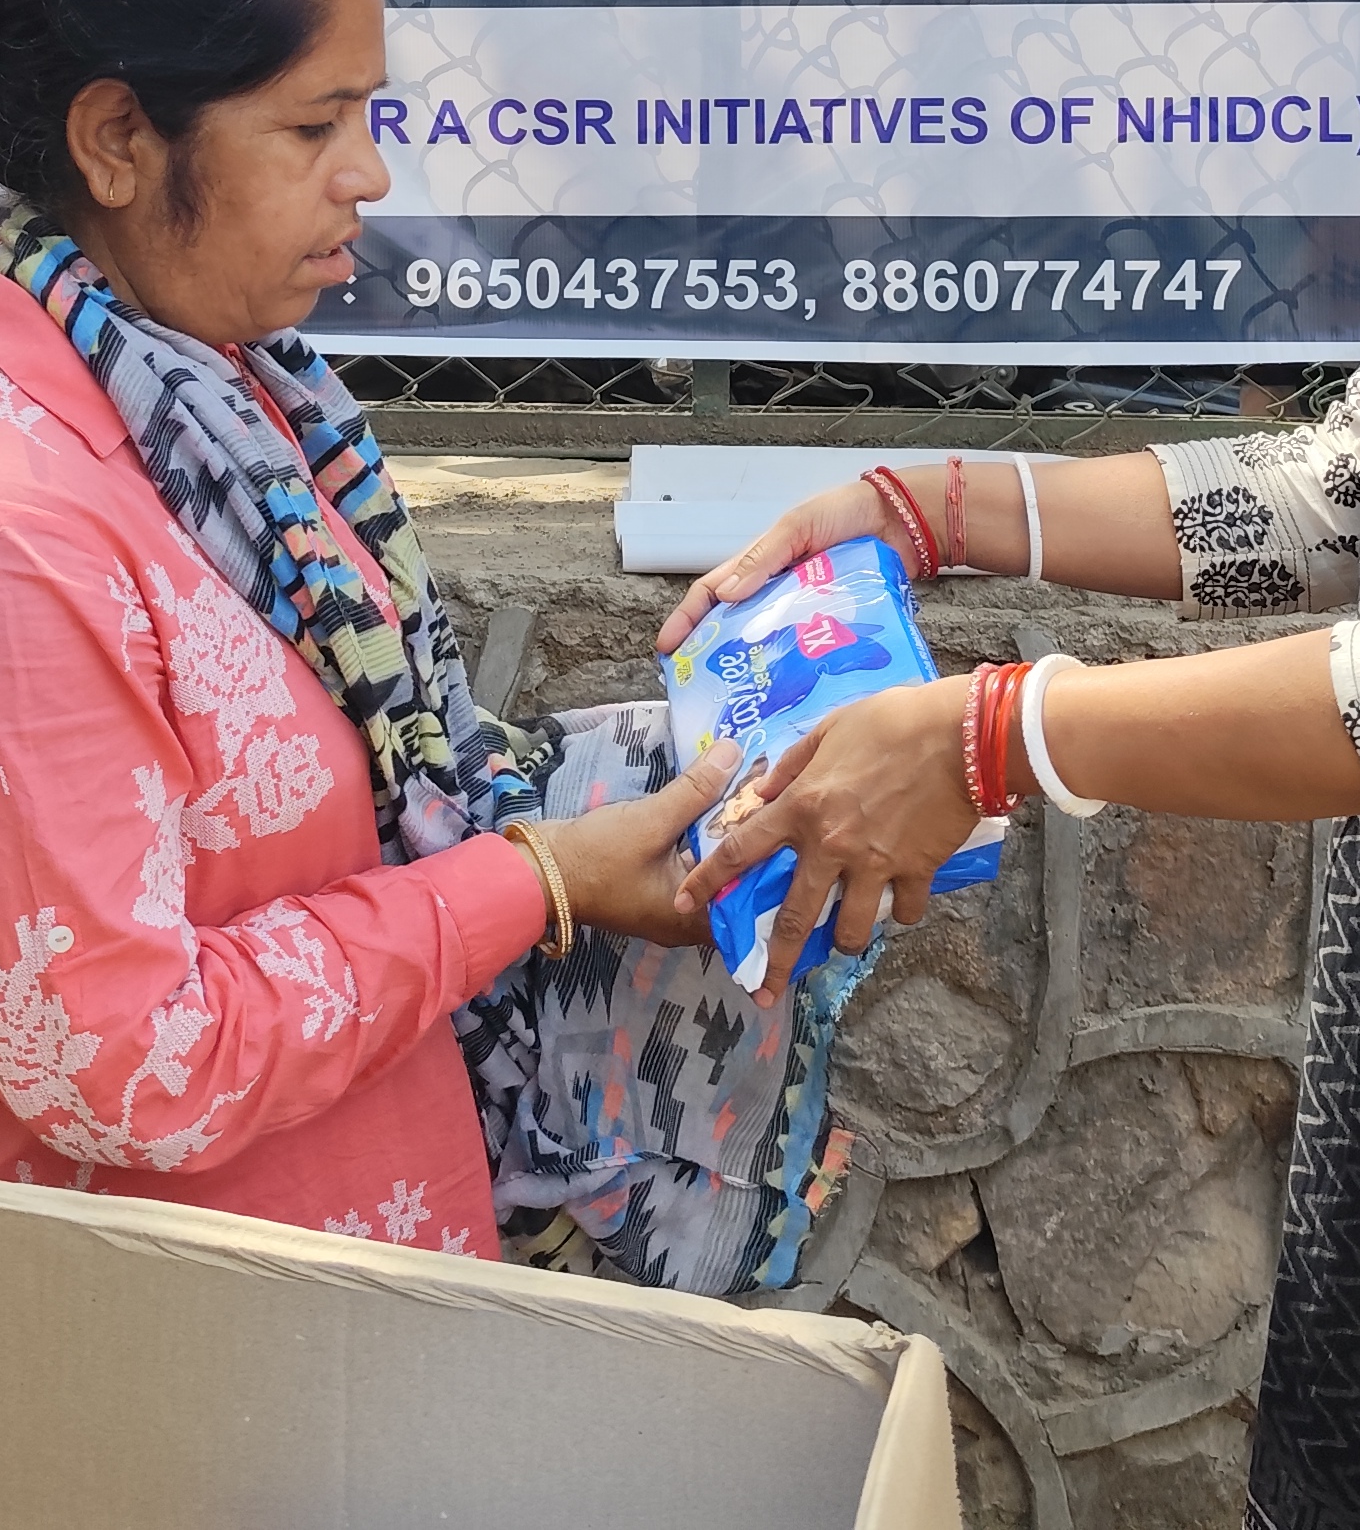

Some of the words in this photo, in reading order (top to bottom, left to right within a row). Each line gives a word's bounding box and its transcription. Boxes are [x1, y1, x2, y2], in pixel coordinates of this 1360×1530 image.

[427, 100, 471, 144] A
[488, 98, 616, 145] CSR
[639, 97, 989, 146] INITIATIVES
[1011, 96, 1094, 144] OF
[406, 258, 817, 320] 9650437553,
[842, 258, 1242, 312] 8860774747
[803, 620, 836, 654] XL
